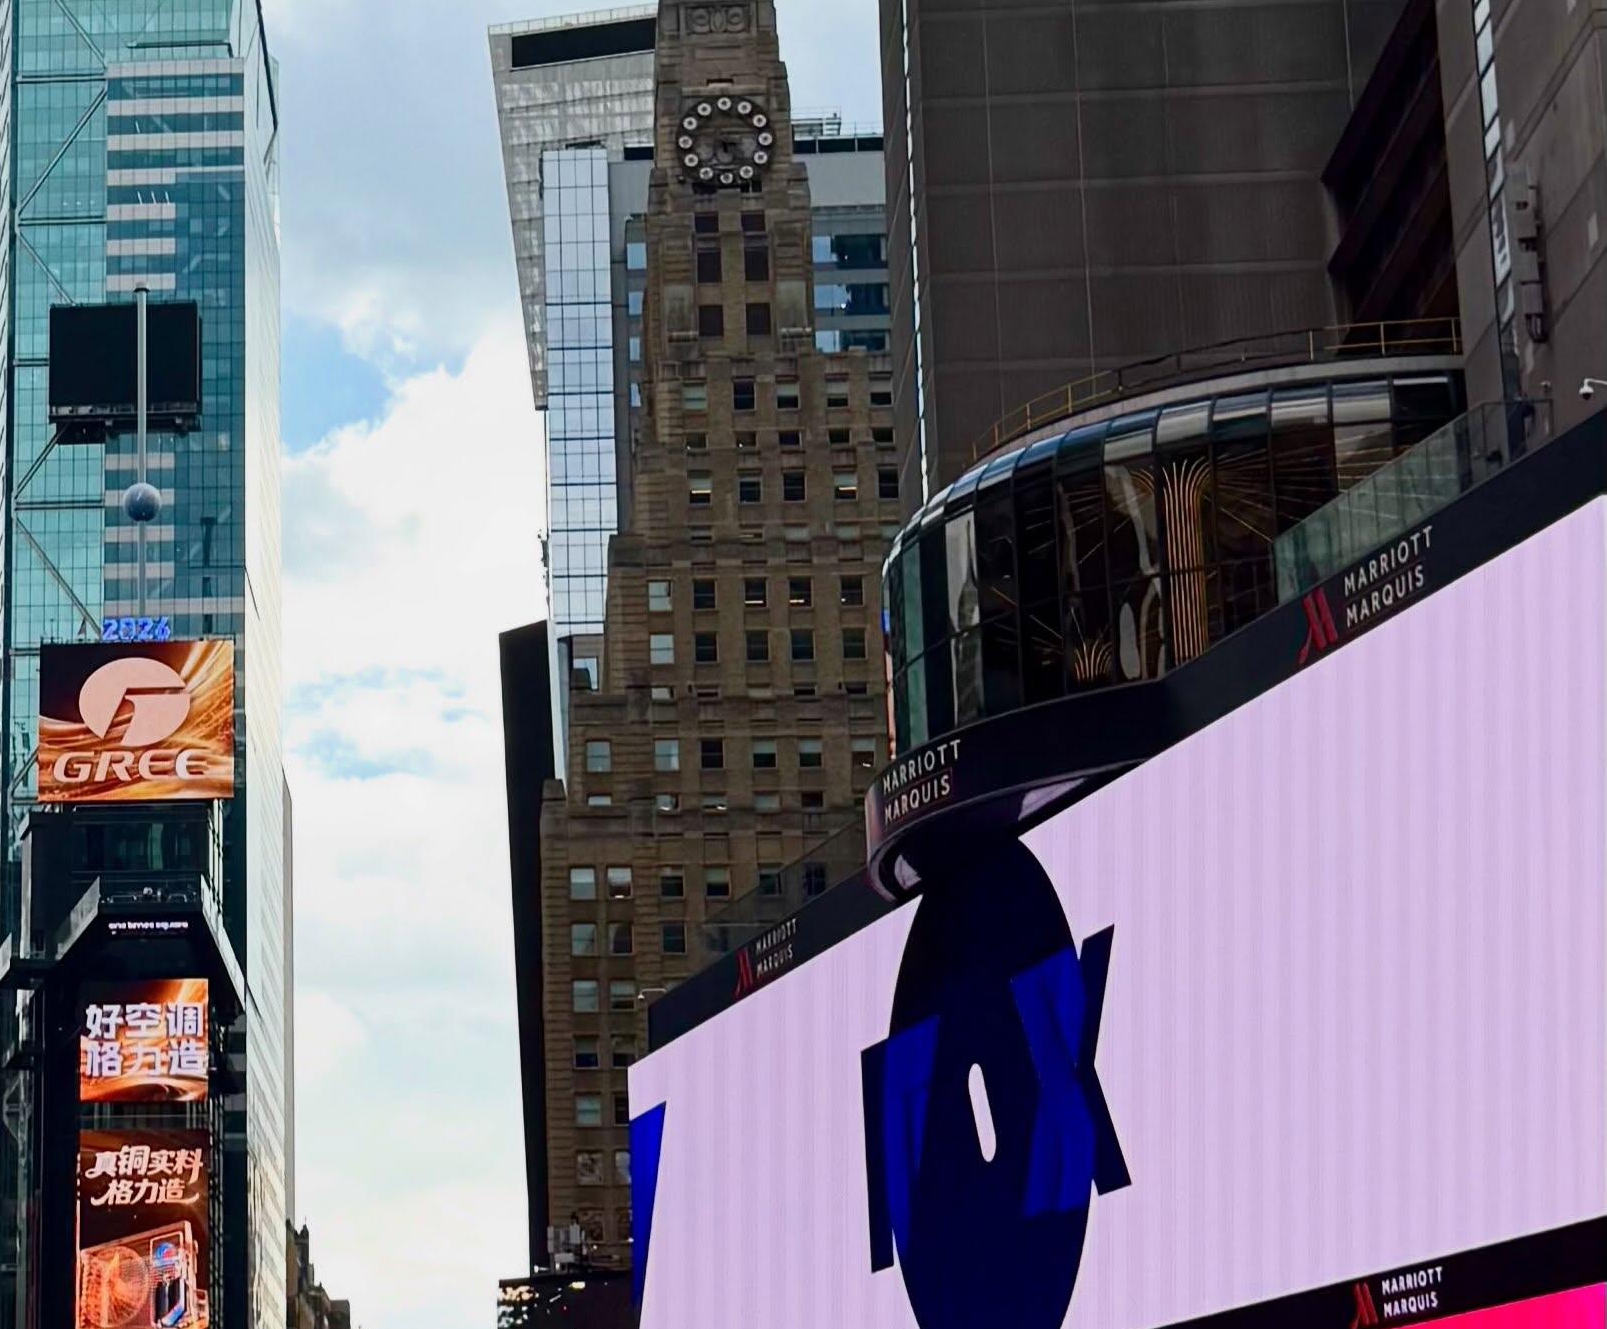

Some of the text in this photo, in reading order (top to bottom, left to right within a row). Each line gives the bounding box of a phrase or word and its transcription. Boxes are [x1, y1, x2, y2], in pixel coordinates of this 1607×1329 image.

[1343, 525, 1433, 597] MARRIOTT
[1346, 565, 1425, 627] MARQUIS
[101, 616, 171, 641] 2026
[53, 748, 208, 783] GREE
[883, 739, 961, 795] MARRIOTT
[884, 775, 950, 826] MARQUIS
[84, 1001, 204, 1041] 好空调
[83, 1039, 209, 1078] 格力造
[105, 1178, 188, 1207] 格力造
[1382, 1266, 1443, 1295] MARRIOTT
[1383, 1291, 1438, 1318] MARQUIS
